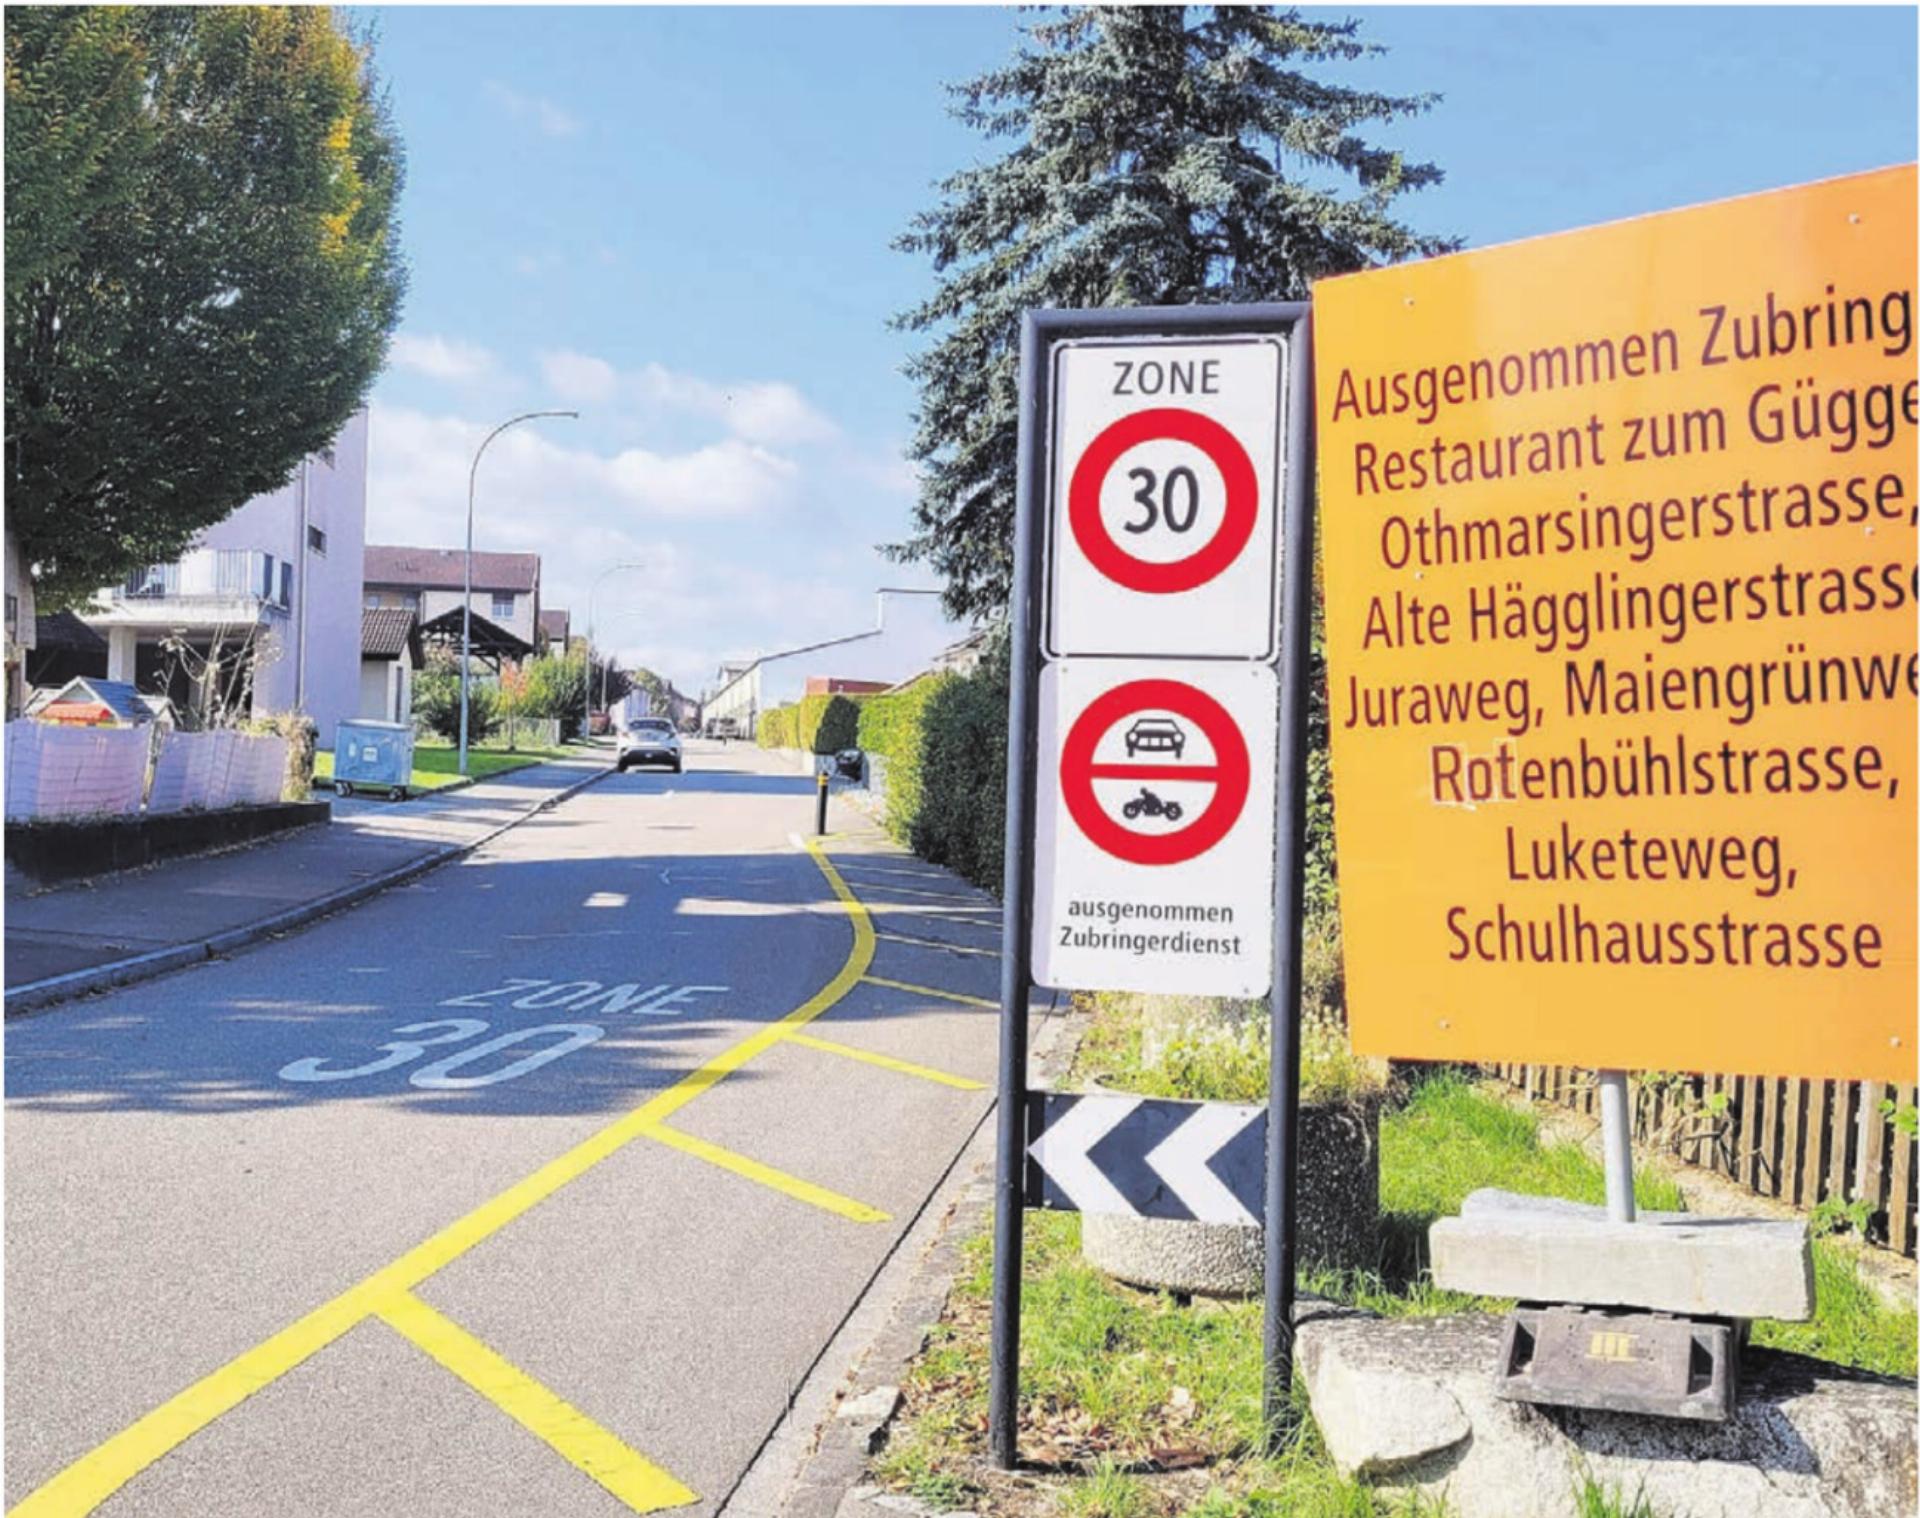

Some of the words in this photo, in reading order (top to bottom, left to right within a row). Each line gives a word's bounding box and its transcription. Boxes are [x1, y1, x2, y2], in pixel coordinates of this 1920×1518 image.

[1112, 360, 1220, 395] ZONE
[1331, 328, 1679, 424] Ausgenommen
[1699, 284, 1912, 367] Zubring
[1354, 415, 1606, 495] Restaurant
[1623, 406, 1728, 462] zum
[1123, 466, 1200, 534] 30
[1380, 472, 1918, 569] Othmarsingerstrasse,
[1362, 591, 1452, 651] Alte
[1468, 562, 1918, 653] Hägglingerstrass
[1344, 674, 1546, 737] Juraweg,
[1431, 734, 1900, 803] Rotenbühlstrasse,
[1506, 821, 1799, 898] Luketeweg,
[1059, 926, 1242, 956] Zubringerdienst
[1067, 900, 1234, 925] ausgenommen
[1446, 904, 1883, 970] Schulhausstrasse
[438, 979, 730, 1016] ZONE
[279, 1018, 606, 1090] 30
